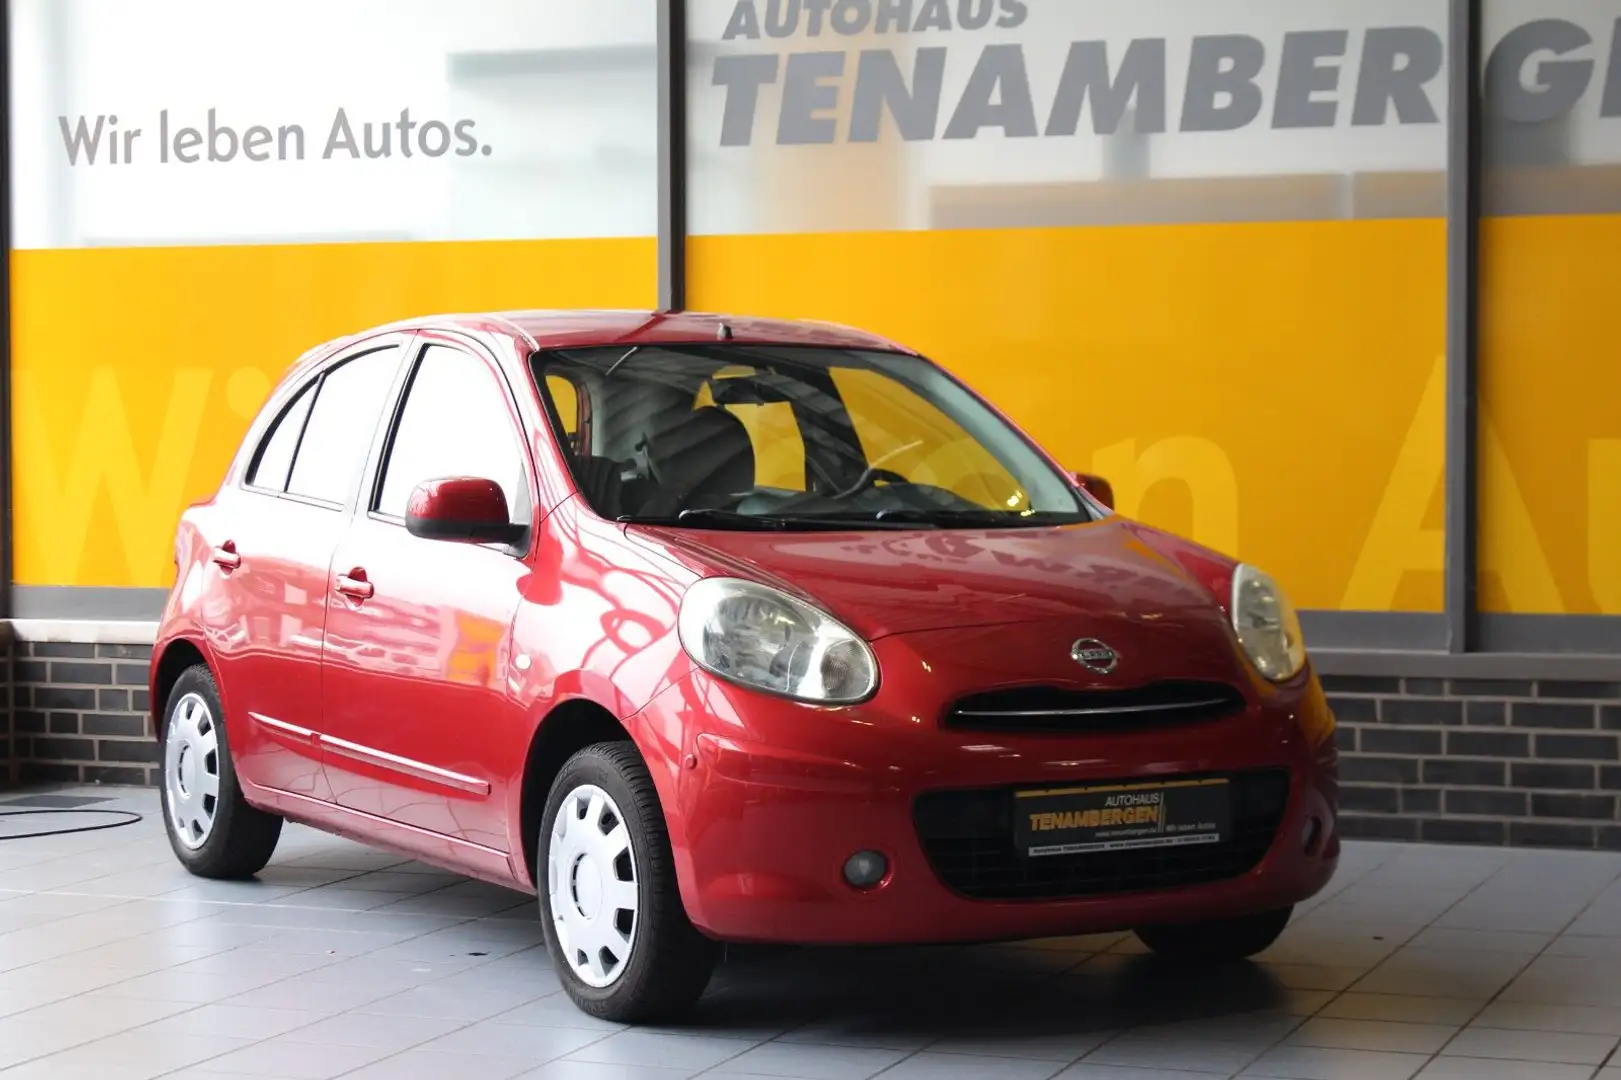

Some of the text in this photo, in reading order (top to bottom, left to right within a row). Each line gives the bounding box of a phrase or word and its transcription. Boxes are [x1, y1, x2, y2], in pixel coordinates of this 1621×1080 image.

[721, 0, 1028, 40] AUTOHAUS
[58, 106, 494, 167] Wir leben Autos.
[1105, 792, 1161, 807] AUTOHAUS
[1029, 805, 1159, 831] TENAMBERGEN
